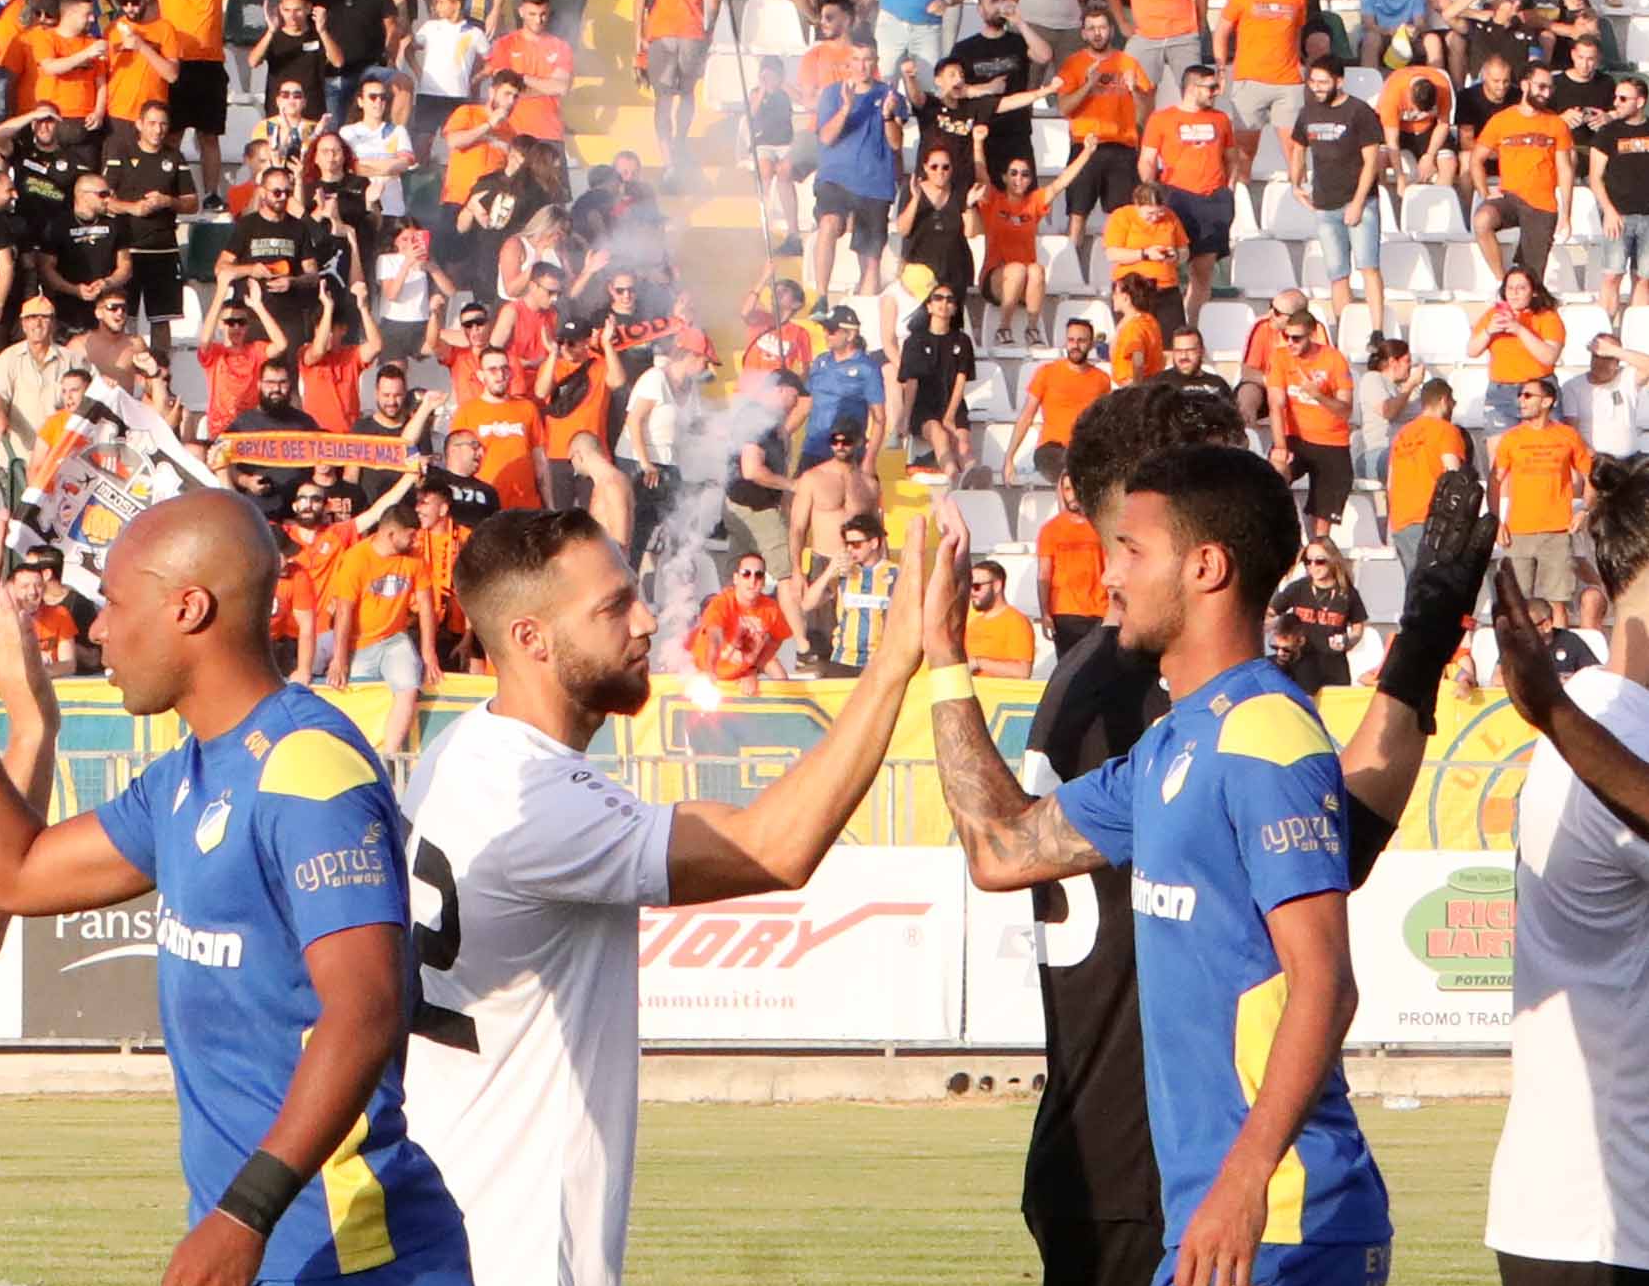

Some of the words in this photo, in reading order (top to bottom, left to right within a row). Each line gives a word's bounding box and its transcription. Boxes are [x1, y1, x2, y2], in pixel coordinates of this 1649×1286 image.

[54, 910, 156, 940] Pans
[638, 901, 934, 968] TORY
[1397, 1010, 1462, 1027] PROMO
